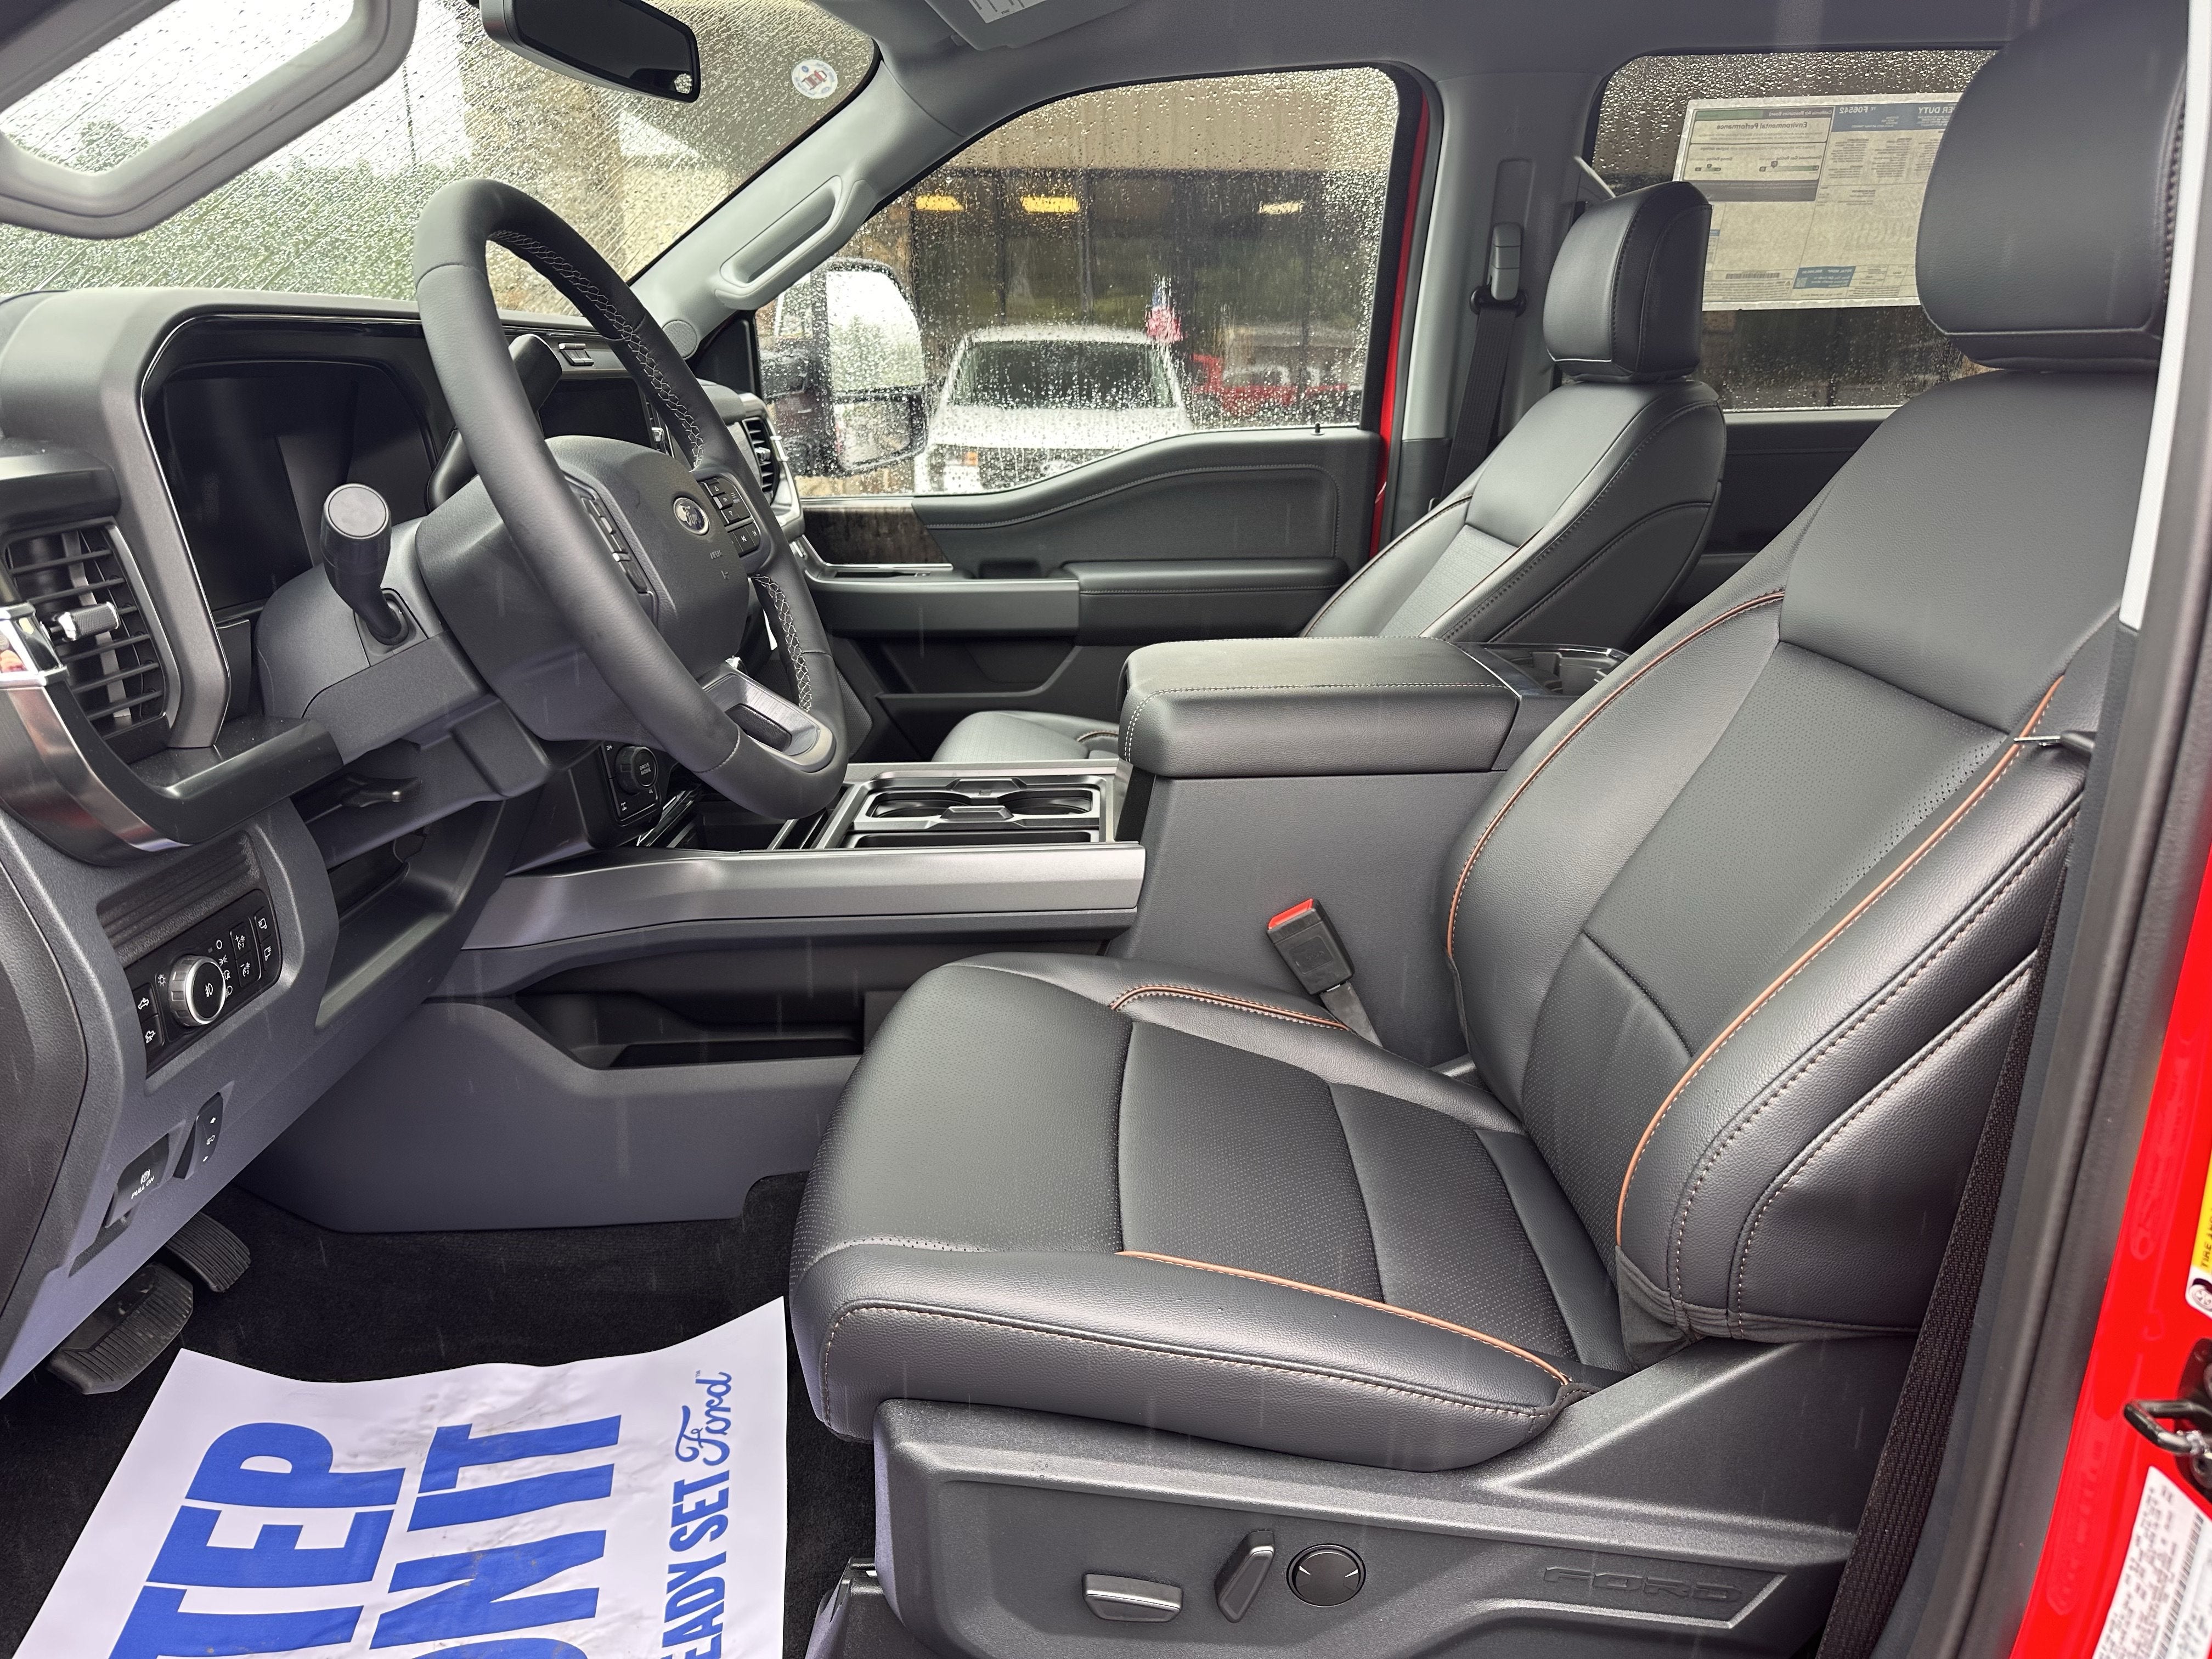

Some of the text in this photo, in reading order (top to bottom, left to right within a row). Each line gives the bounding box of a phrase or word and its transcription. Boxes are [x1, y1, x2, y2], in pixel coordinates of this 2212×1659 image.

[131, 1175, 155, 1200] PULL ON
[675, 1371, 732, 1466] Ford
[407, 1414, 622, 1532] IT
[669, 1470, 730, 1552] SET
[108, 1422, 405, 1659] TEP
[1543, 1566, 1742, 1602] FORD
[660, 1550, 727, 1659] EADY
